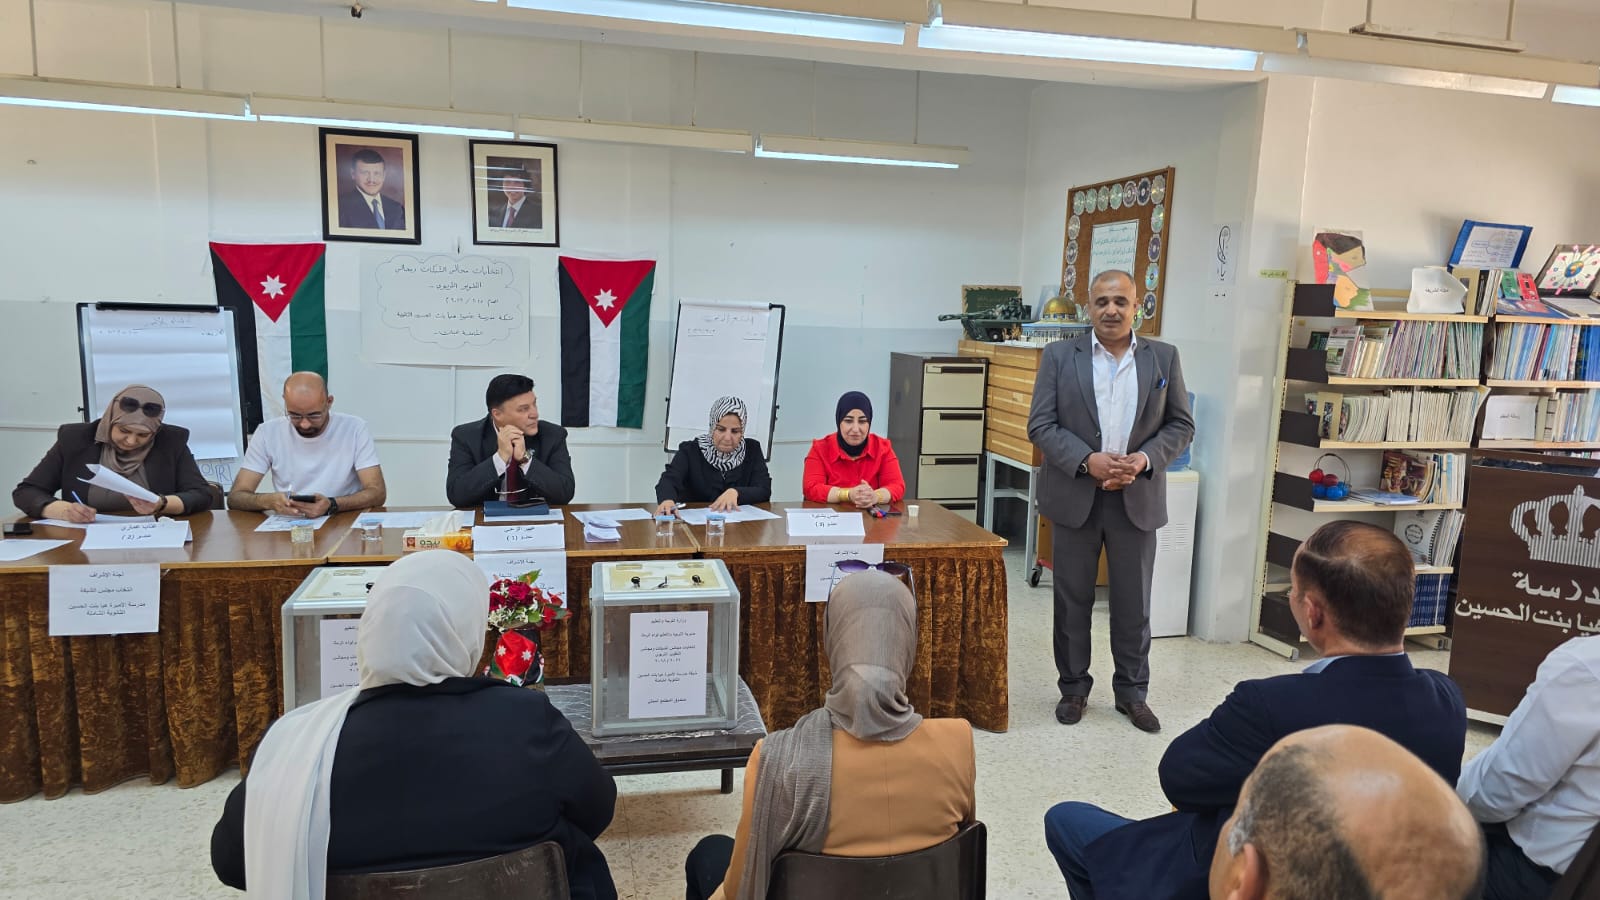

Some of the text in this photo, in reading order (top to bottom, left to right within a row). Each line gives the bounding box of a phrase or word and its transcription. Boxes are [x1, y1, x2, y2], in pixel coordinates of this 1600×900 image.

[1512, 571, 1600, 604] درسة
[1454, 598, 1530, 622] الحسين
[1532, 609, 1572, 633] بنت
